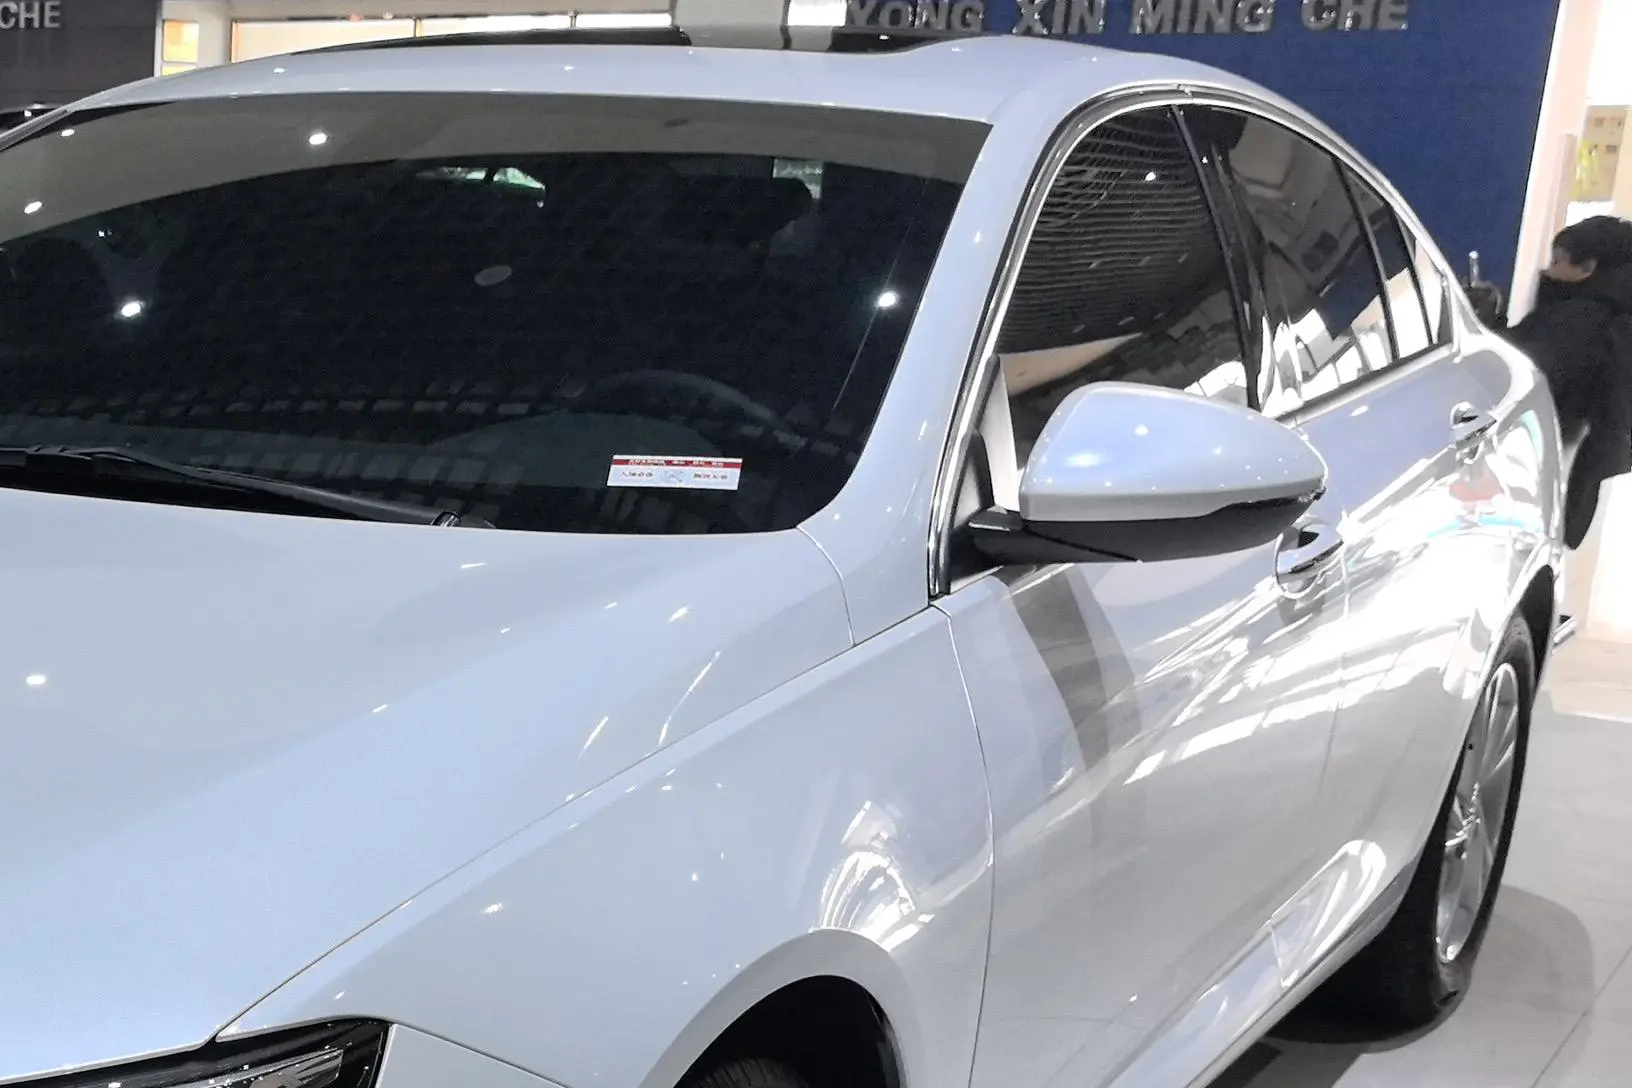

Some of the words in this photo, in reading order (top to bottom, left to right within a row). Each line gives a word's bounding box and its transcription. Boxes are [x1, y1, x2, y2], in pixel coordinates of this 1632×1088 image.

[1012, 0, 1106, 35] XIN
[1128, 0, 1275, 34] MING
[1299, 0, 1409, 32] CHE
